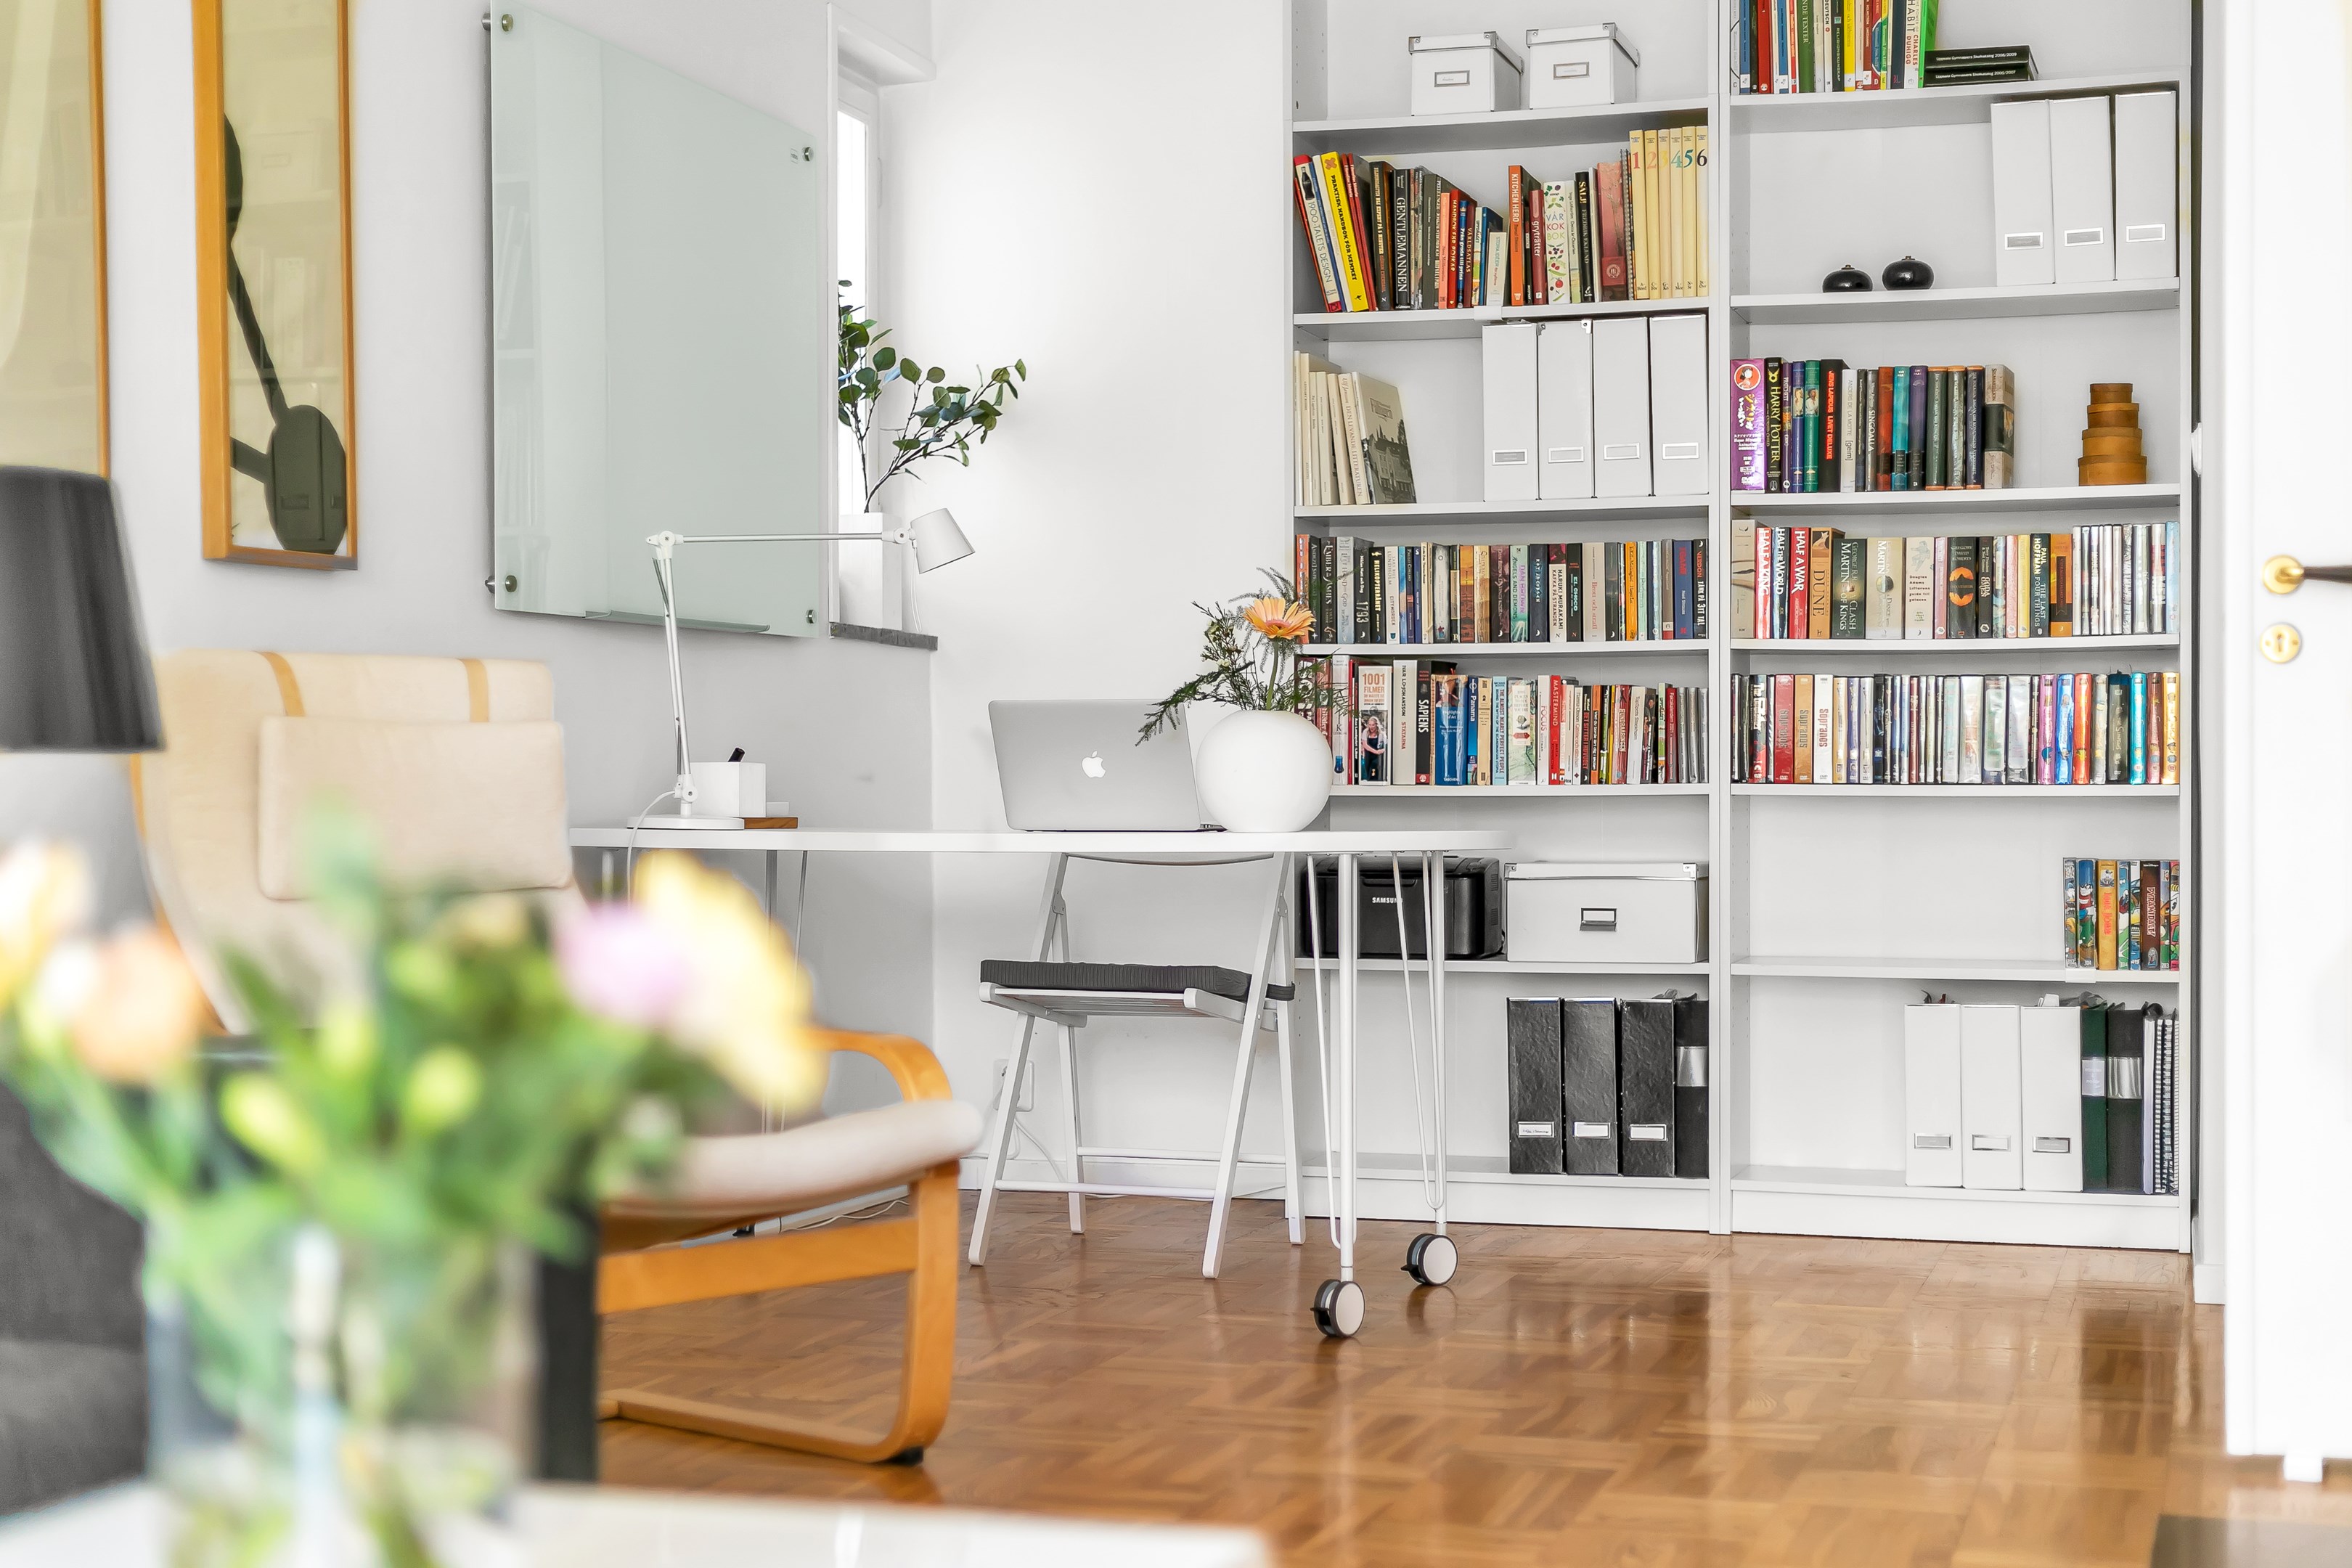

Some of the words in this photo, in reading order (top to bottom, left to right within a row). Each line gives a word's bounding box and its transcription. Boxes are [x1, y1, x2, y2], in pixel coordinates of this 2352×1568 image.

[1906, 0, 1915, 32] HABIT
[1633, 152, 1641, 168] 1
[1647, 151, 1657, 169] 2
[1659, 150, 1668, 168] 3
[1671, 150, 1683, 168] 4
[1683, 149, 1694, 168] 5
[1697, 149, 1707, 166] 6
[1331, 175, 1341, 207] PRAKTISK
[1336, 208, 1348, 240] HANDBOK
[1347, 254, 1357, 280] HEMMET
[1546, 212, 1564, 221] VÅR
[1397, 197, 1408, 292] GENTLEMANNEN
[1317, 253, 1332, 282] DESIGN
[1771, 386, 1780, 422] HARRY
[1347, 421, 1357, 449] LEVANDE
[1771, 425, 1781, 463] POTTER
[1845, 440, 1853, 461] [geim]
[1351, 451, 1363, 497] LITTERATUREN
[1759, 530, 1770, 558] HALF
[1776, 528, 1785, 550] HALF
[1794, 531, 1805, 555] HALF
[1841, 542, 1851, 583] MARTIN
[1877, 540, 1887, 574] MARTIN
[1758, 568, 1769, 596] KING
[1773, 561, 1785, 595] WORLD
[1791, 566, 1805, 594] WAR
[1813, 570, 1825, 616] DUNE
[1840, 593, 1846, 603] OF
[1356, 602, 1368, 623] 1793
[1849, 600, 1858, 629] CLASH
[1363, 674, 1384, 685] 1001
[1418, 699, 1429, 732] SAPIENS
[1778, 710, 1789, 748] Sopranos
[1798, 710, 1809, 748] Sopranos
[1818, 709, 1829, 747] Sopranos
[2147, 886, 2156, 937] PYRAMIDALT!
